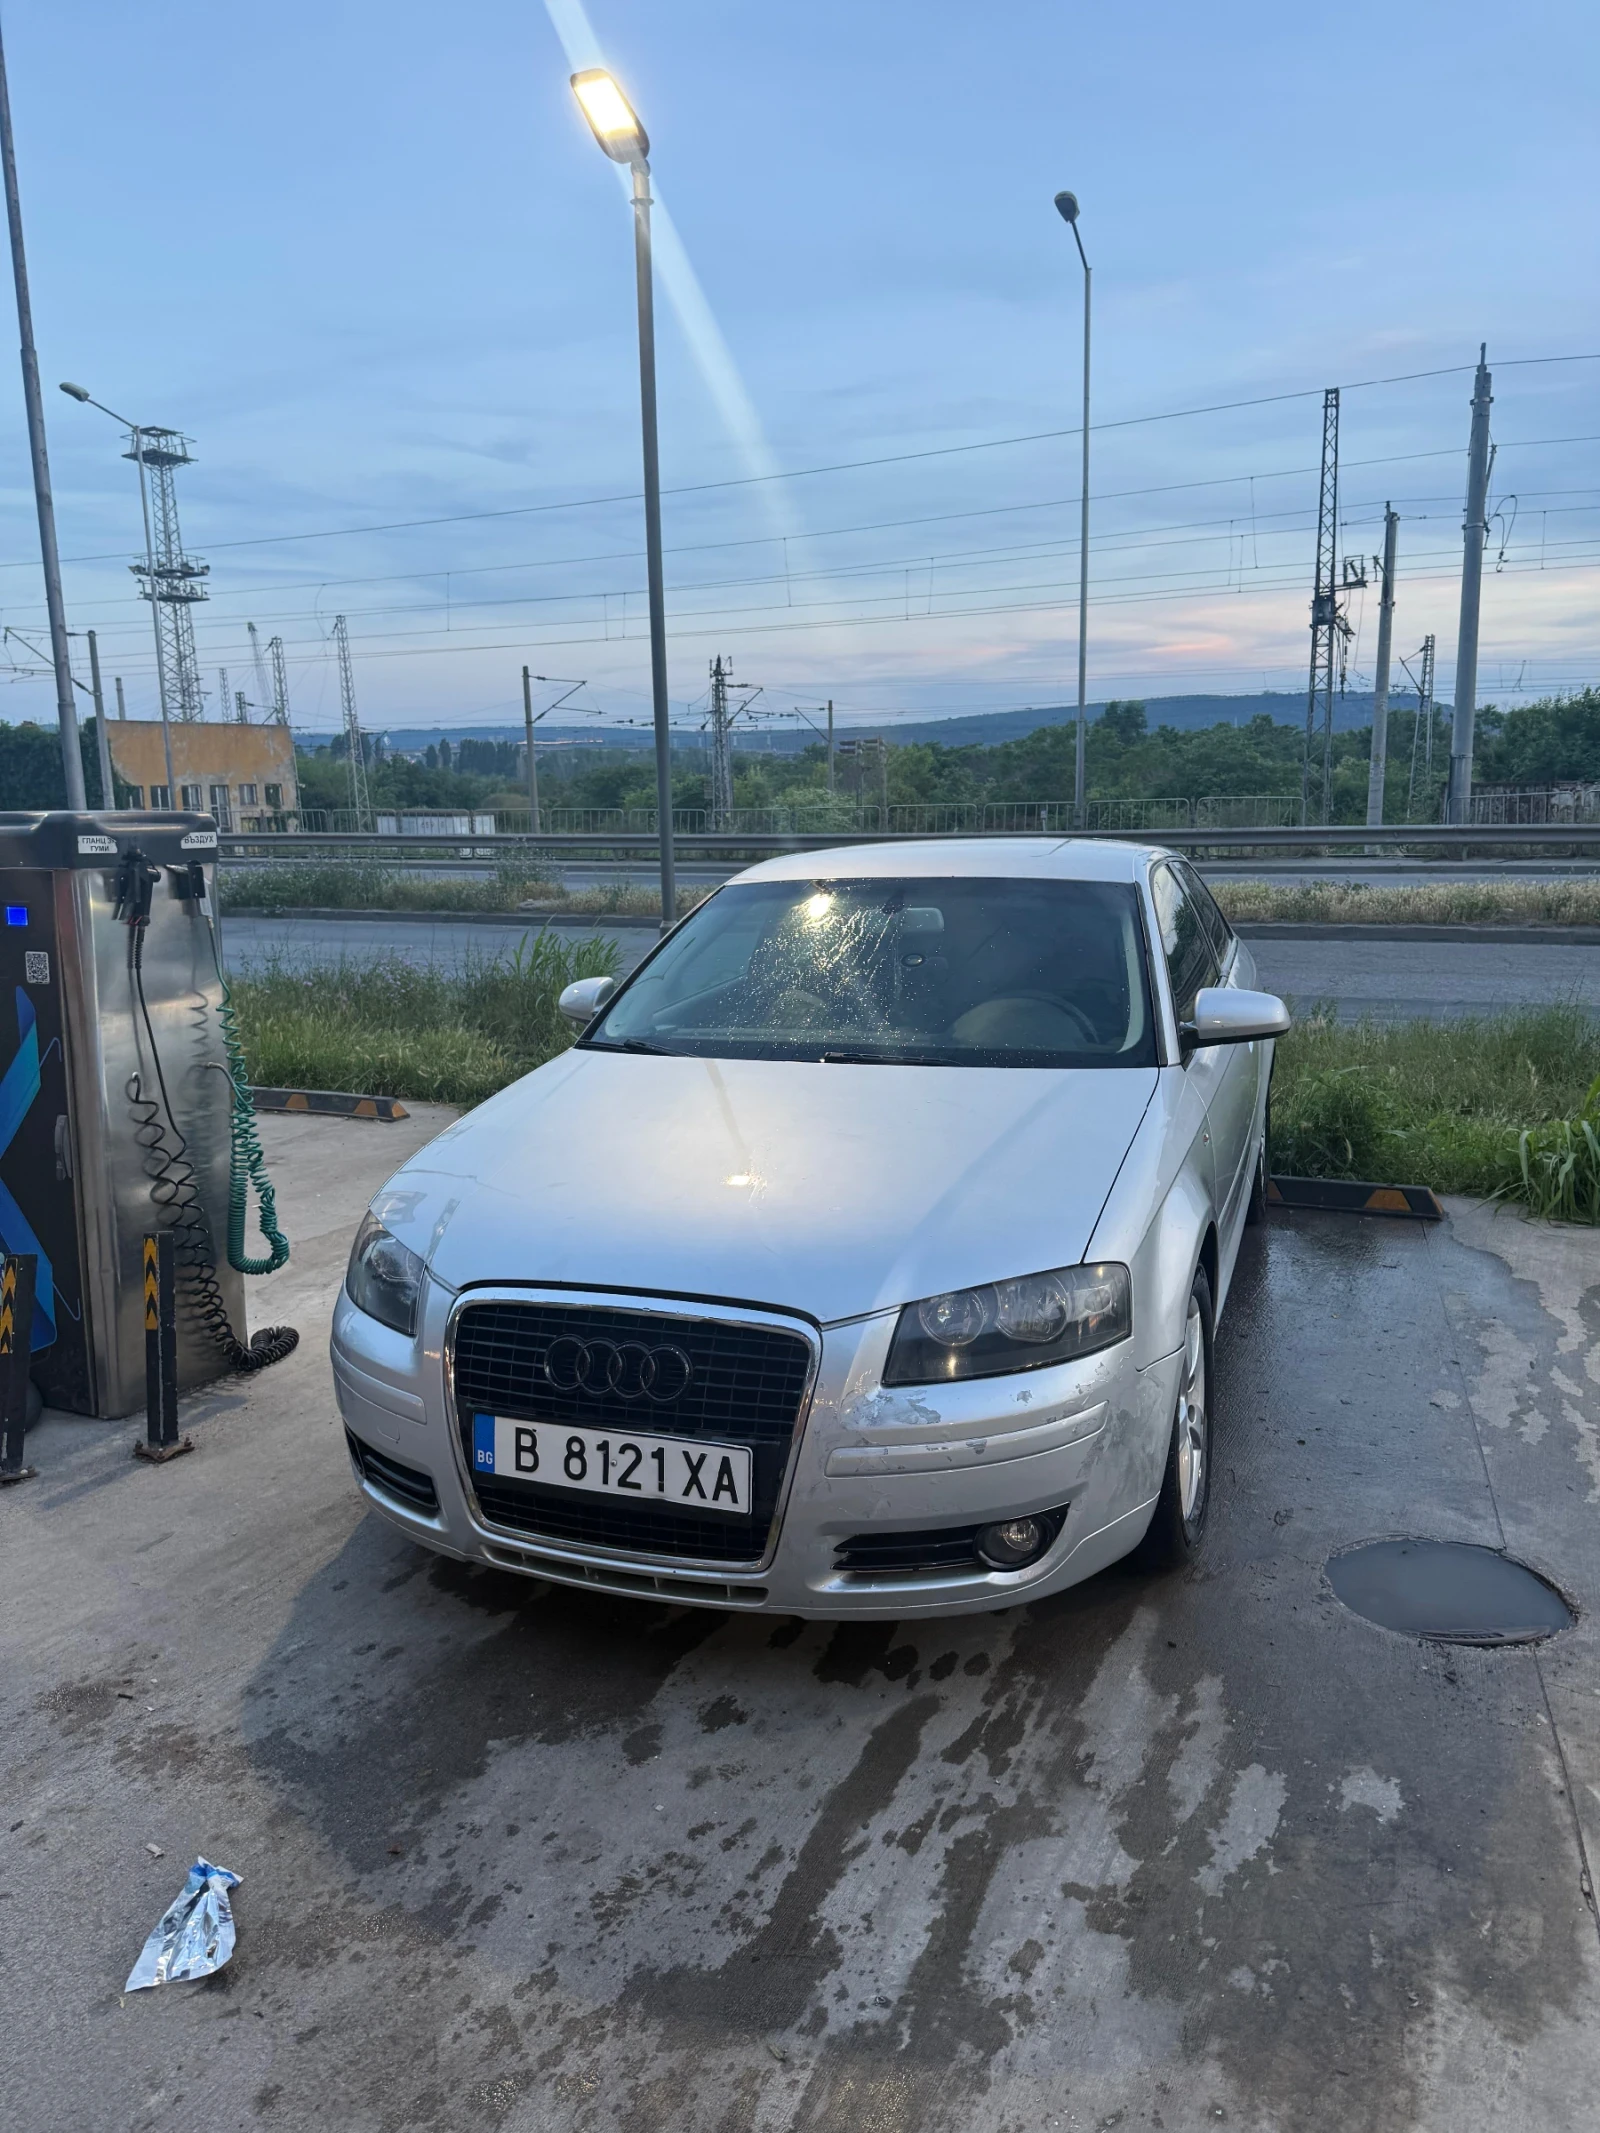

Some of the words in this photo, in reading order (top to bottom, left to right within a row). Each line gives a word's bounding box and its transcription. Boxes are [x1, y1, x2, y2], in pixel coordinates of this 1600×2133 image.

[81, 837, 106, 845] ГЛАНЦ
[184, 835, 214, 845] ВЪЗДУХ
[476, 1448, 494, 1465] BG
[514, 1426, 540, 1473] B
[563, 1435, 665, 1493] 8121
[681, 1449, 739, 1504] XA
